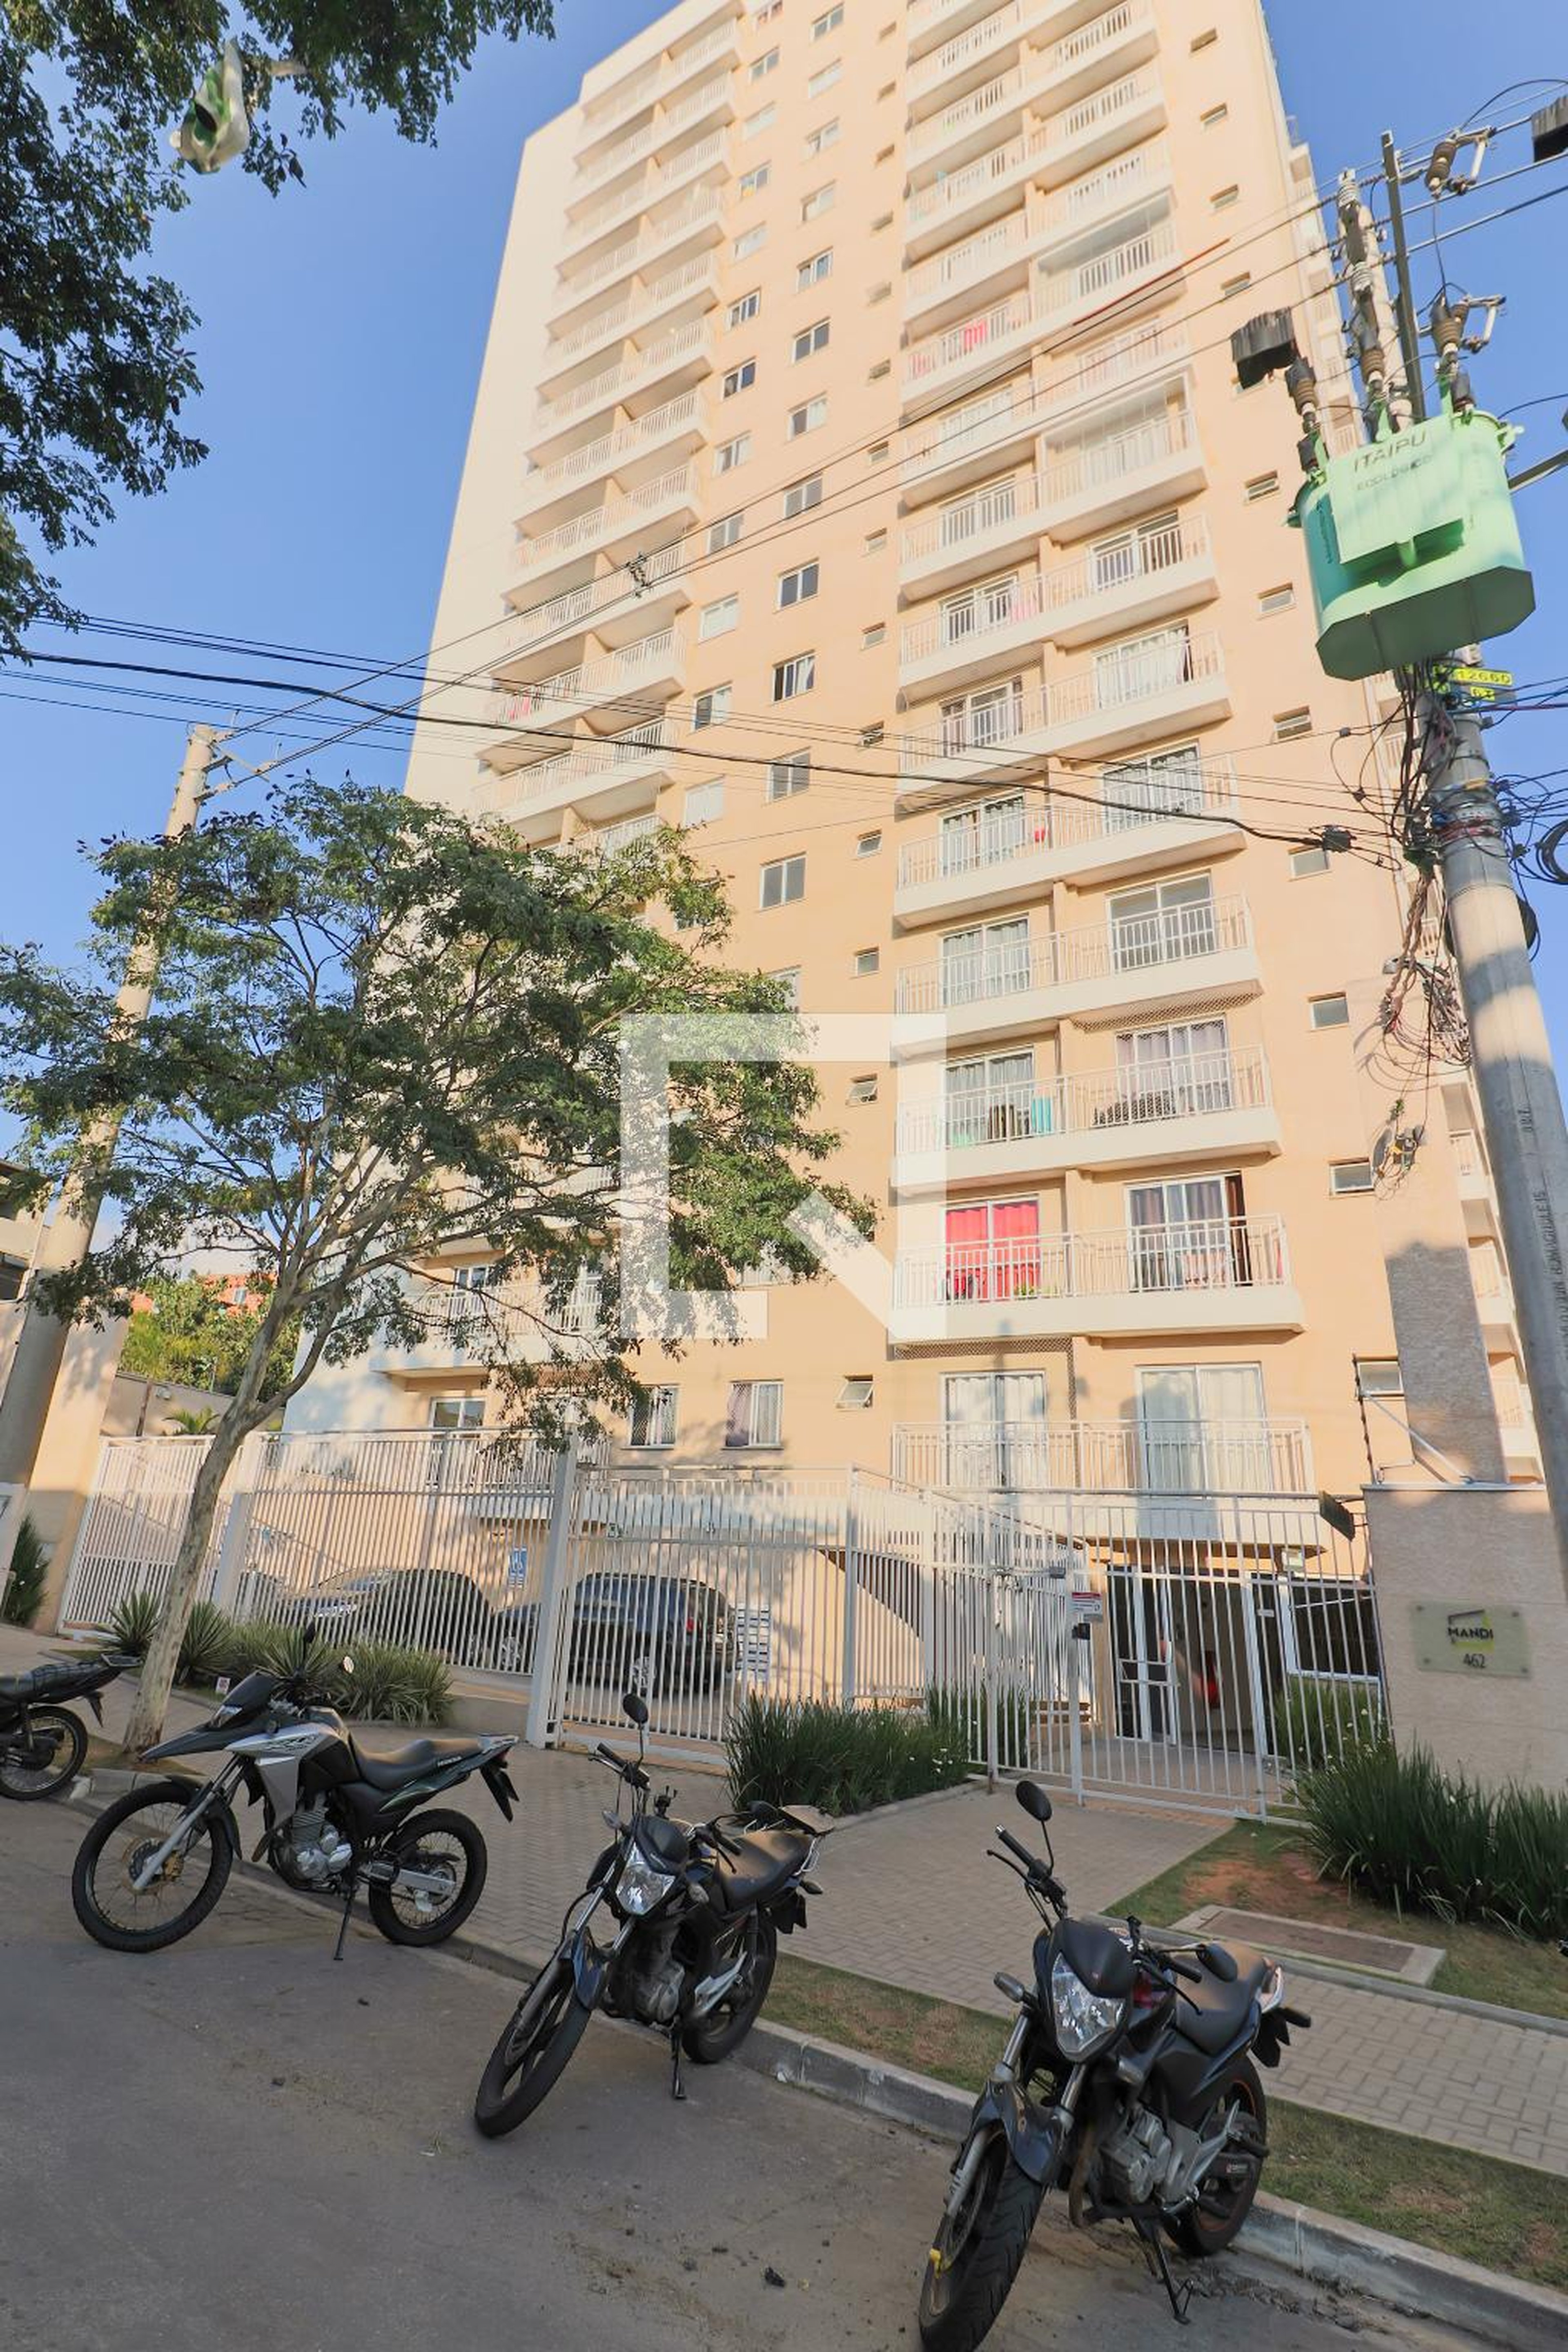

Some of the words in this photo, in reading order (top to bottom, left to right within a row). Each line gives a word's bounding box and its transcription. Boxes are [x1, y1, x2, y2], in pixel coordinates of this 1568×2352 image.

[1354, 429, 1427, 473] ITAIPU
[1448, 1627, 1494, 1640] MANDI
[1463, 1653, 1486, 1668] 462
